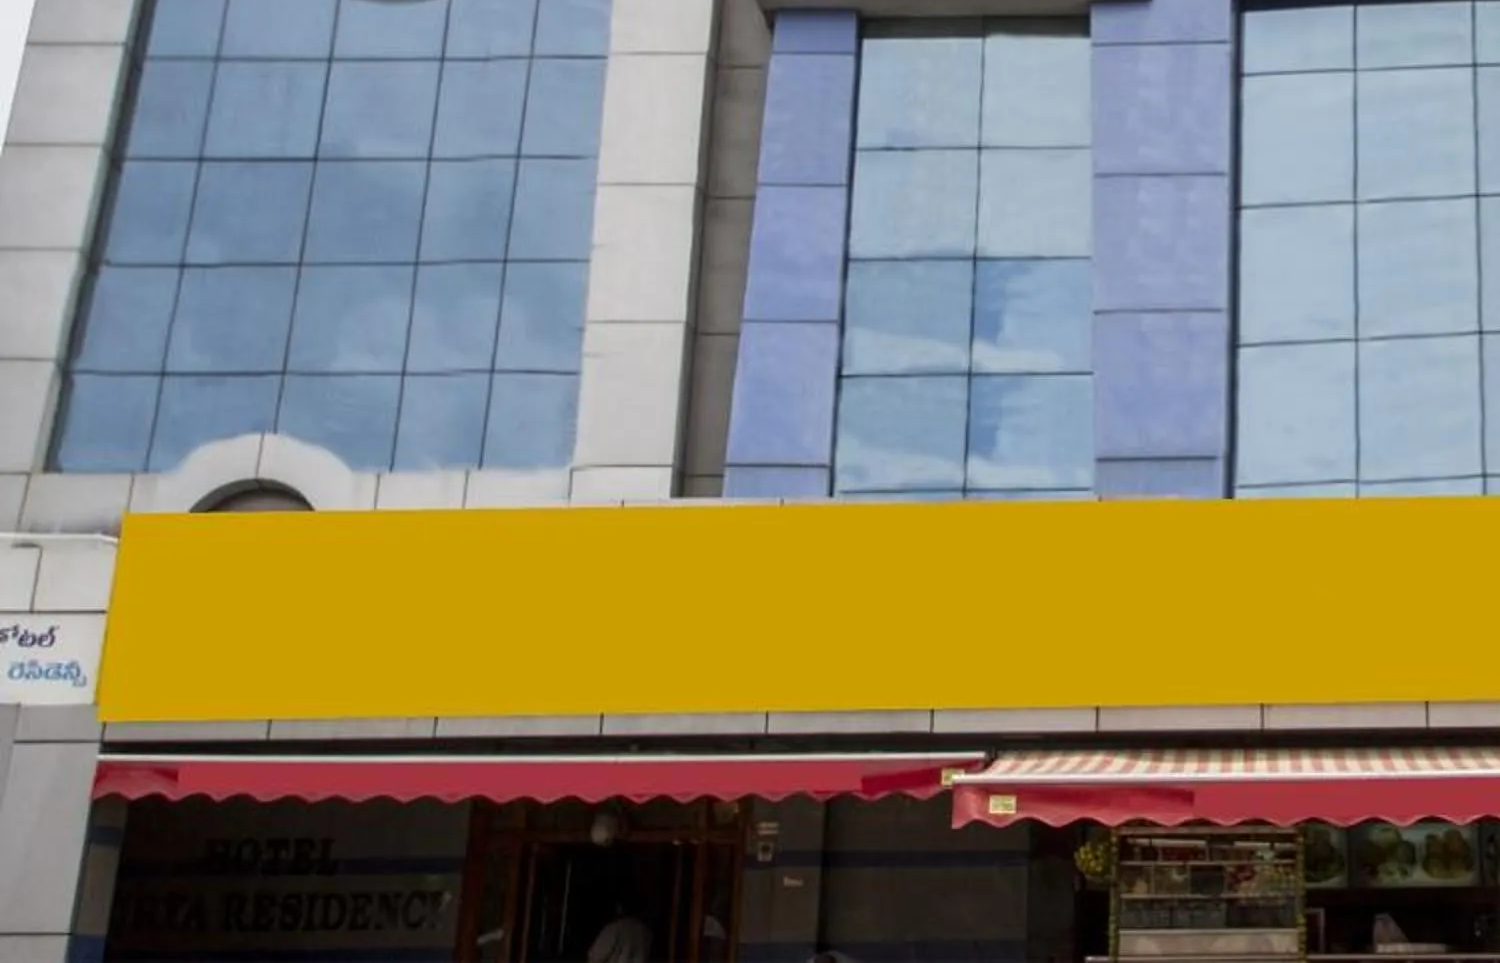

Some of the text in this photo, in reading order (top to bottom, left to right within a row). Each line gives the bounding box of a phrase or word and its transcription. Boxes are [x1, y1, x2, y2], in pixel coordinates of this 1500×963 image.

[206, 837, 339, 875] HOTEL
[113, 889, 453, 932] RYA RESIDENCY
